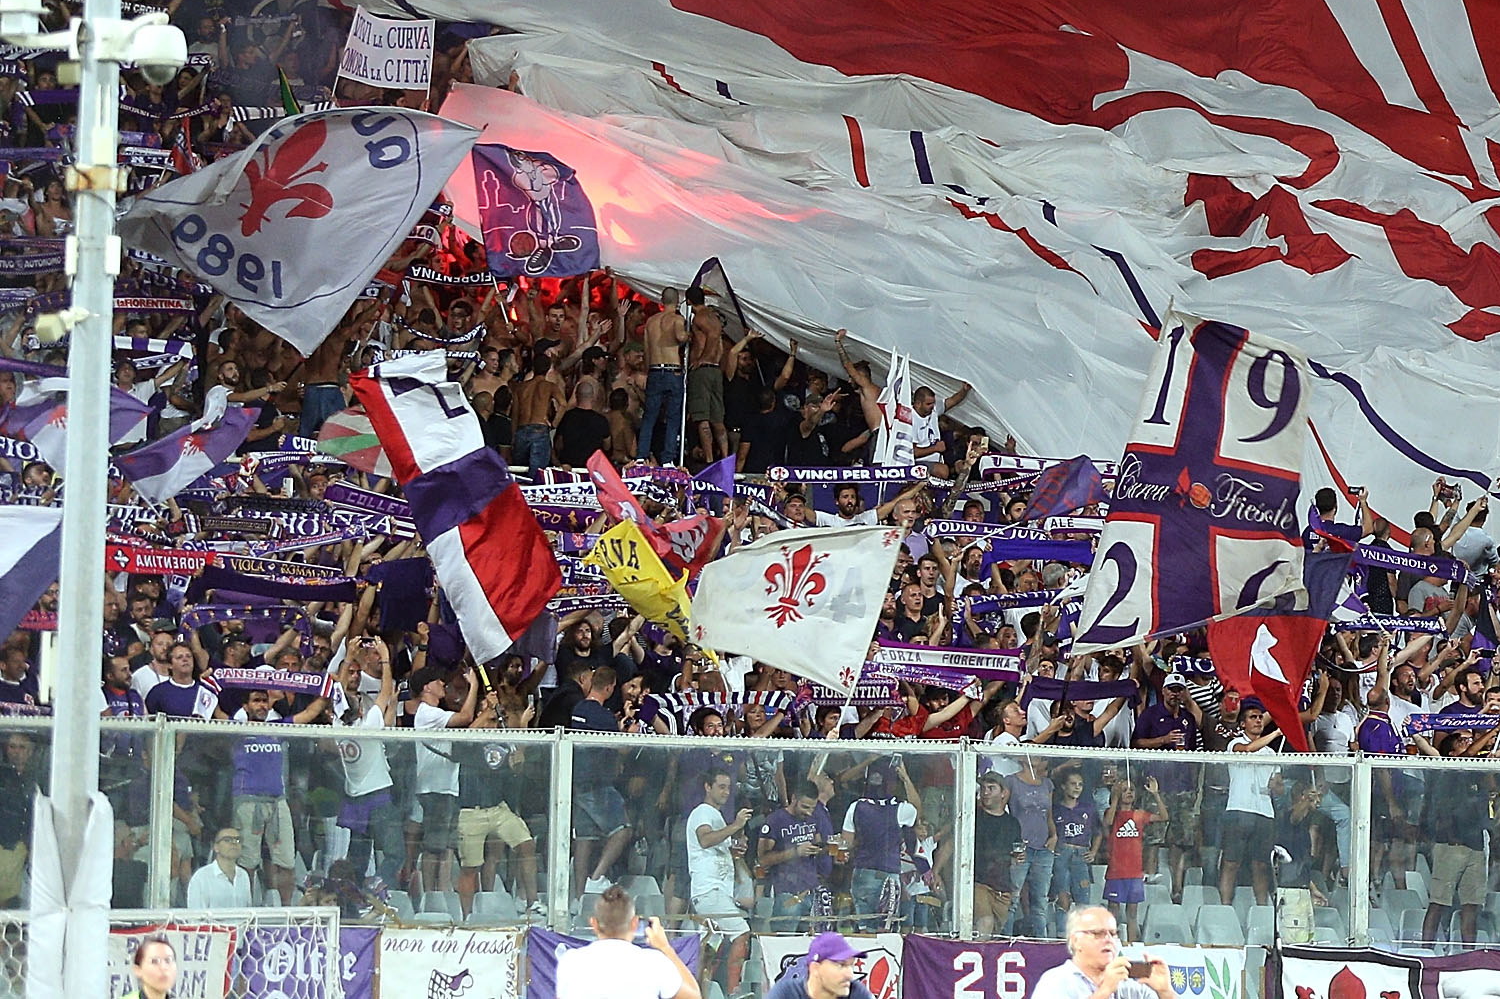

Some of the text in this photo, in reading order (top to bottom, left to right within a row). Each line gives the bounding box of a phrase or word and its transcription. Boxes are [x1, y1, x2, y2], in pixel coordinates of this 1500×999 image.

[373, 35, 382, 48] LA
[387, 25, 430, 50] CURVA
[341, 47, 429, 83] ONORA LA CITTÀ
[124, 298, 183, 309] FIORENTINA
[795, 468, 906, 481] VINCI PER NOI
[1211, 473, 1295, 530] Fiesole
[938, 519, 978, 534] ODIO
[231, 558, 267, 574] VIOLA
[881, 648, 1011, 669] FORZA FIORENTINA
[213, 667, 323, 687] SANSEPOLCRO
[812, 685, 890, 700] FIORNTINA
[1116, 830, 1140, 838] adidas
[383, 932, 516, 964] non un passo
[263, 940, 359, 983] Olte
[953, 951, 1026, 999] 26
